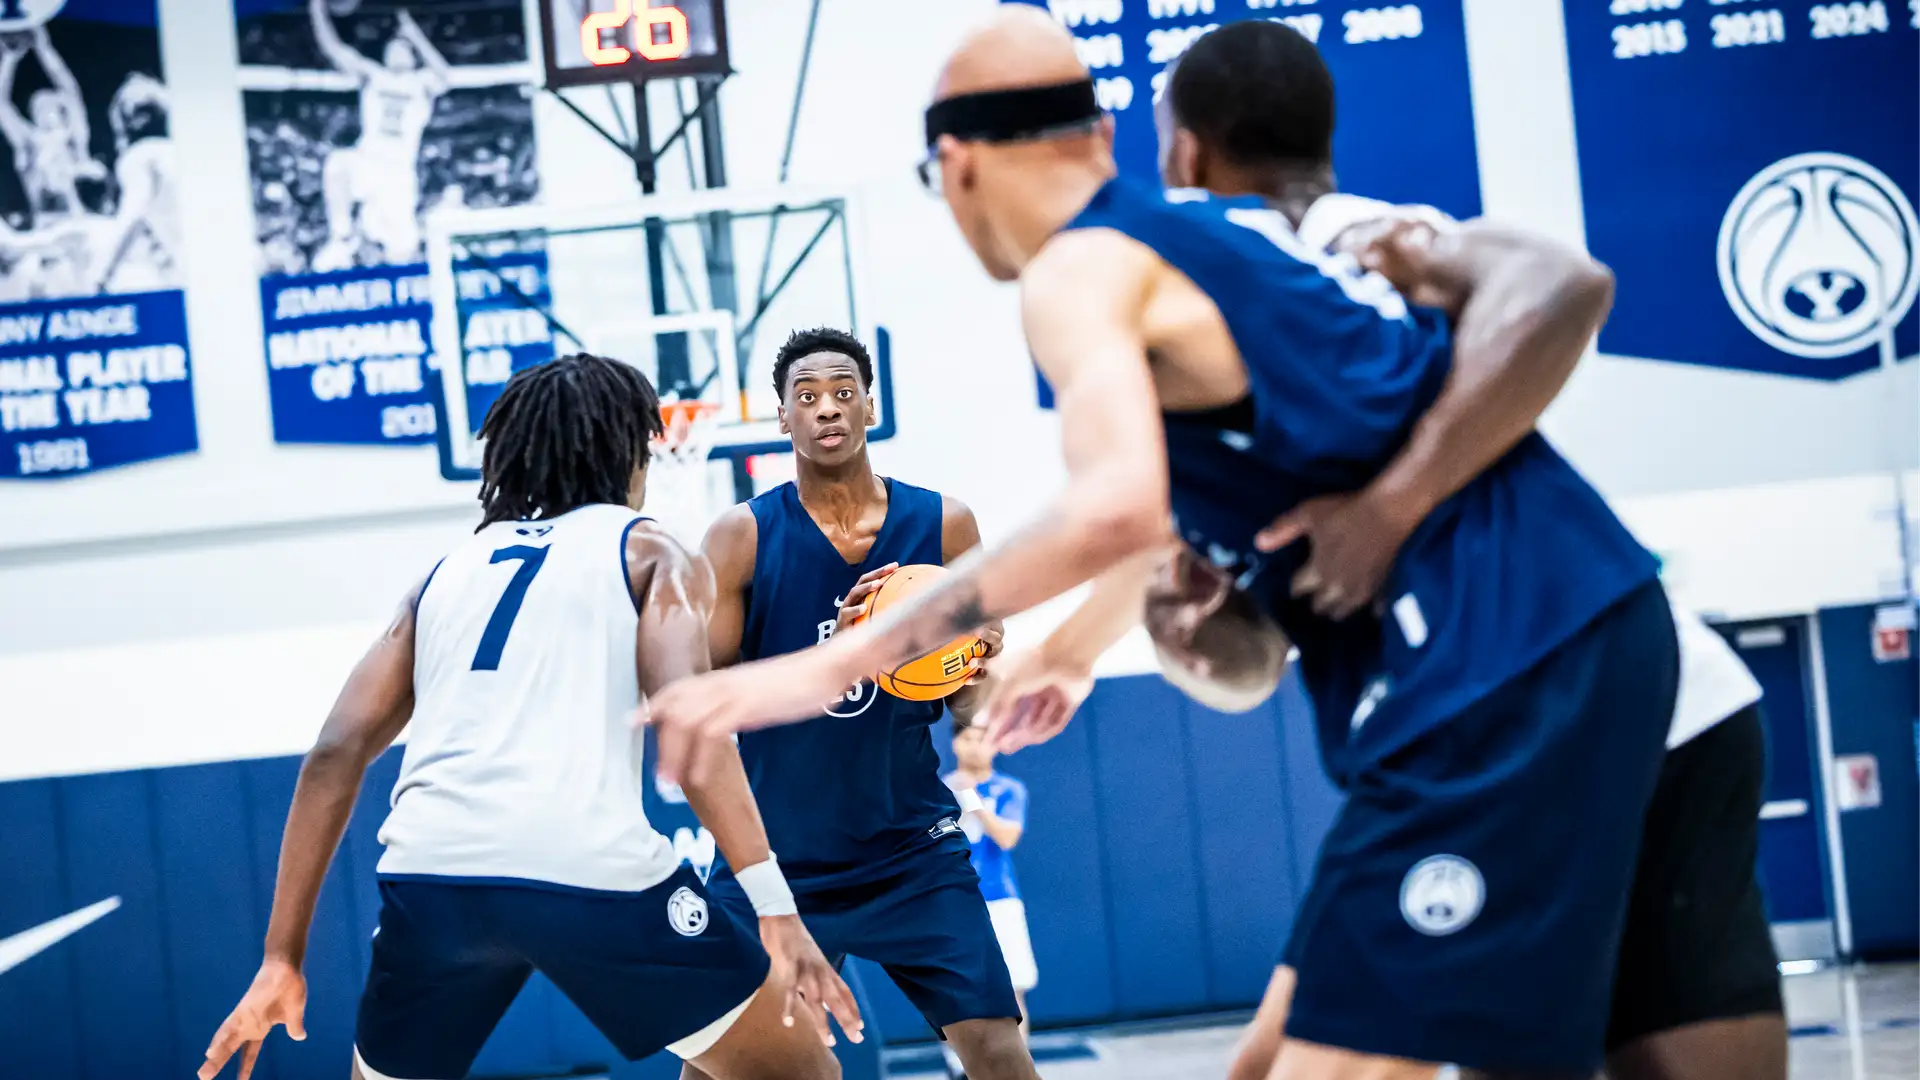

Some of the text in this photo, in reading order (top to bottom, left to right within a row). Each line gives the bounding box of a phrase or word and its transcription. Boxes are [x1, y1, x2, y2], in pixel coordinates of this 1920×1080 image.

[269, 308, 553, 370] NATIONAL AYER
[67, 343, 187, 389] PLAYER
[311, 362, 356, 401] OF
[360, 356, 424, 396] THE
[64, 385, 152, 426] YEAR
[380, 402, 438, 438] 201
[470, 543, 553, 671] 7
